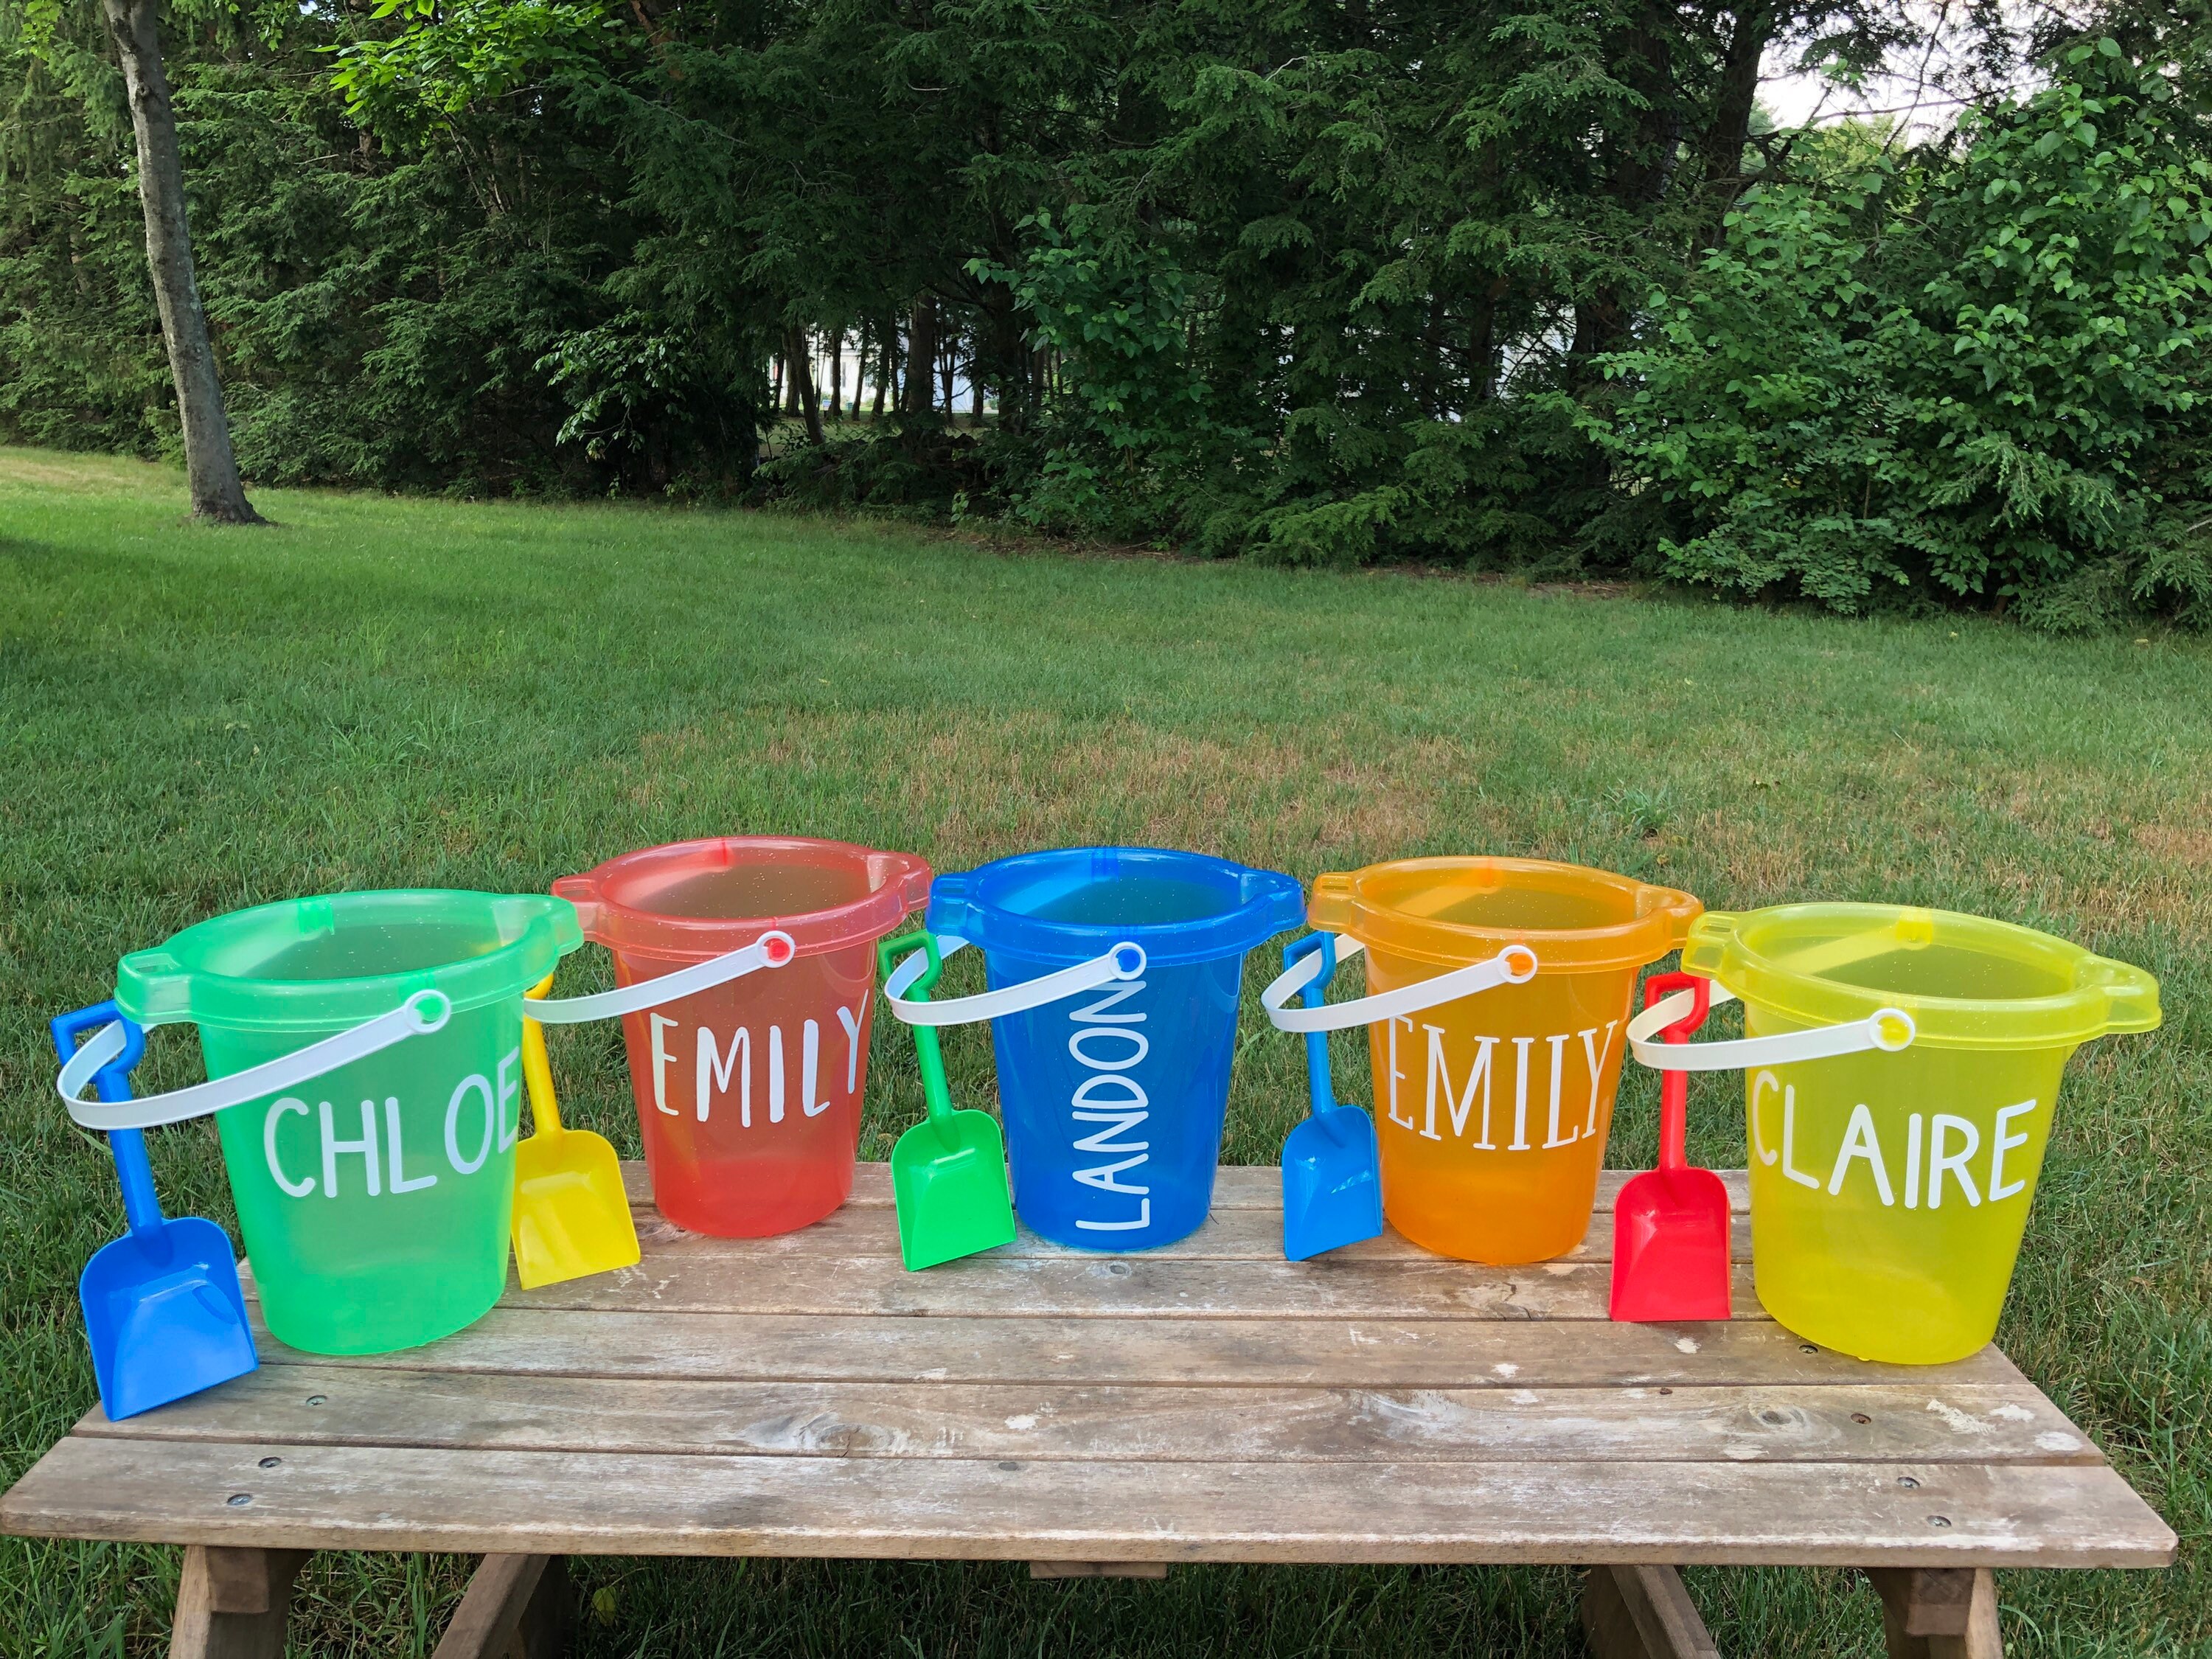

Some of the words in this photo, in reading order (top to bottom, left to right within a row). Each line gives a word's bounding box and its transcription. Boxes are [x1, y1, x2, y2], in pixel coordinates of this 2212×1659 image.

[262, 1046, 520, 1198] CHLOE
[650, 990, 869, 1127] EMILY
[1068, 979, 1150, 1231] LANDON
[1388, 1015, 1618, 1150] EMILY
[1753, 1070, 2037, 1208] CLAIRE
